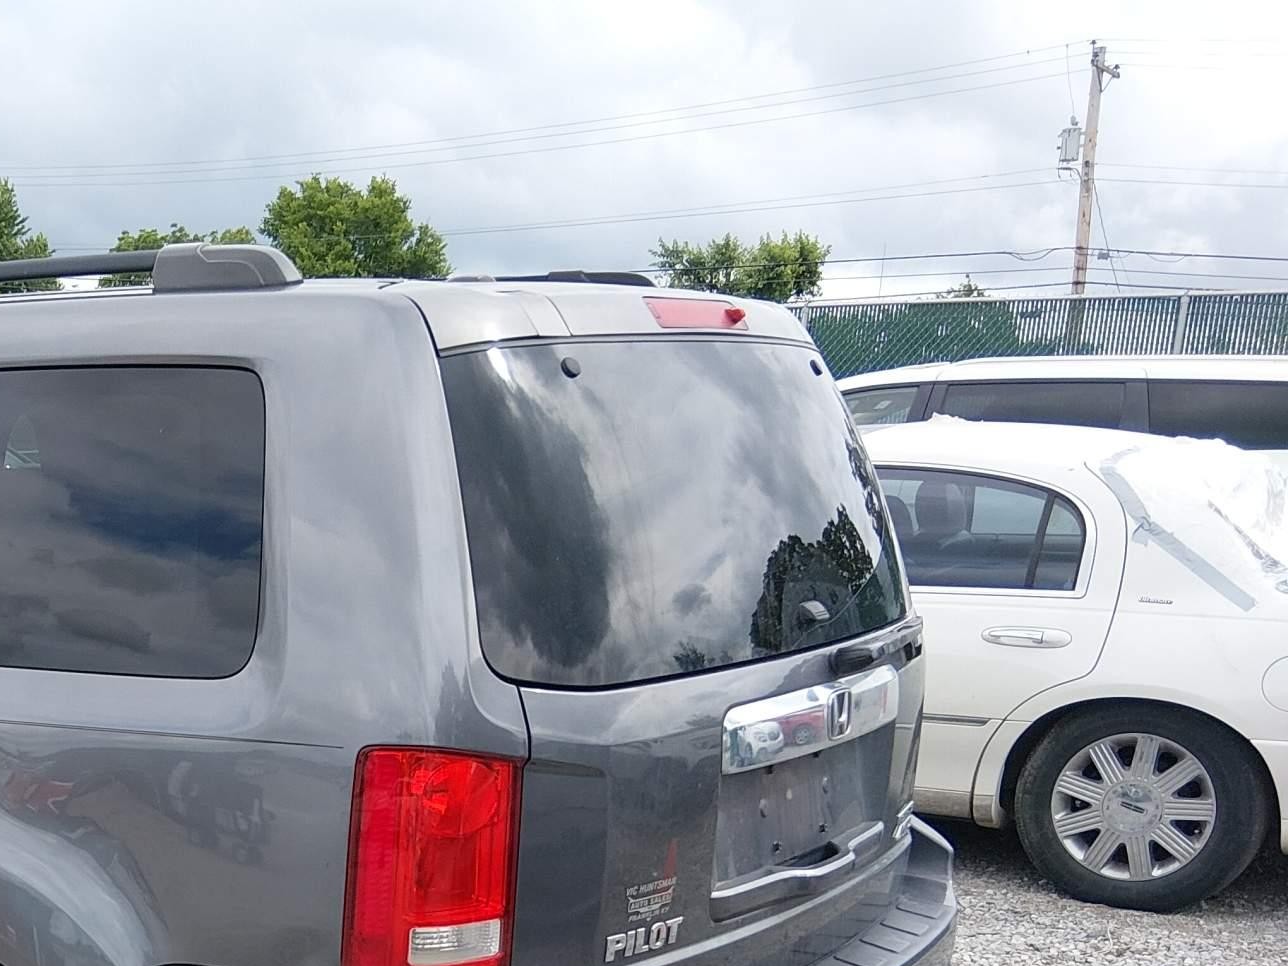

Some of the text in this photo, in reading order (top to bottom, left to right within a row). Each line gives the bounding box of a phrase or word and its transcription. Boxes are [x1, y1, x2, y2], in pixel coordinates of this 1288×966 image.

[626, 886, 638, 896] VIC
[631, 893, 672, 910] AUTO SALES
[605, 916, 684, 963] PILOT
